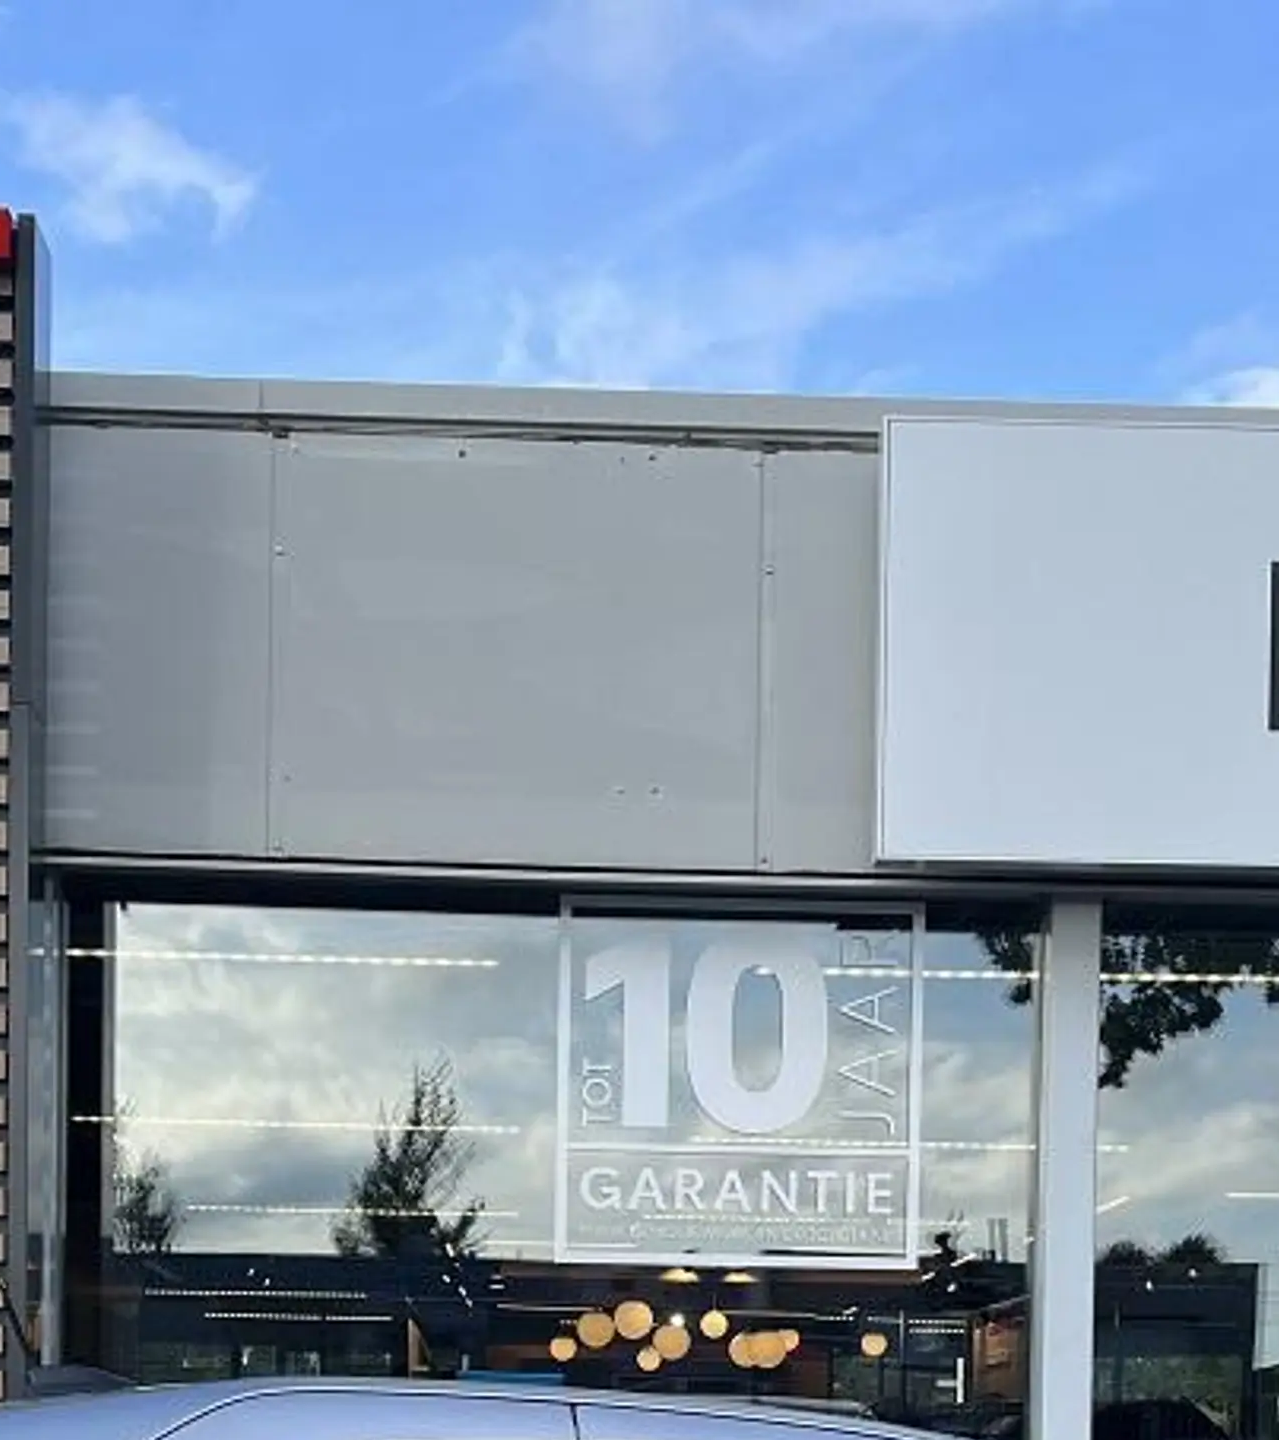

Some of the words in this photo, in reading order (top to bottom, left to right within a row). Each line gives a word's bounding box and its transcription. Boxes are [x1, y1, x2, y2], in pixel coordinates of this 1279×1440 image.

[582, 1057, 612, 1126] TOT
[585, 940, 828, 1134] 10
[838, 930, 900, 1135] JAAR
[580, 1167, 894, 1215] GARANTIE
